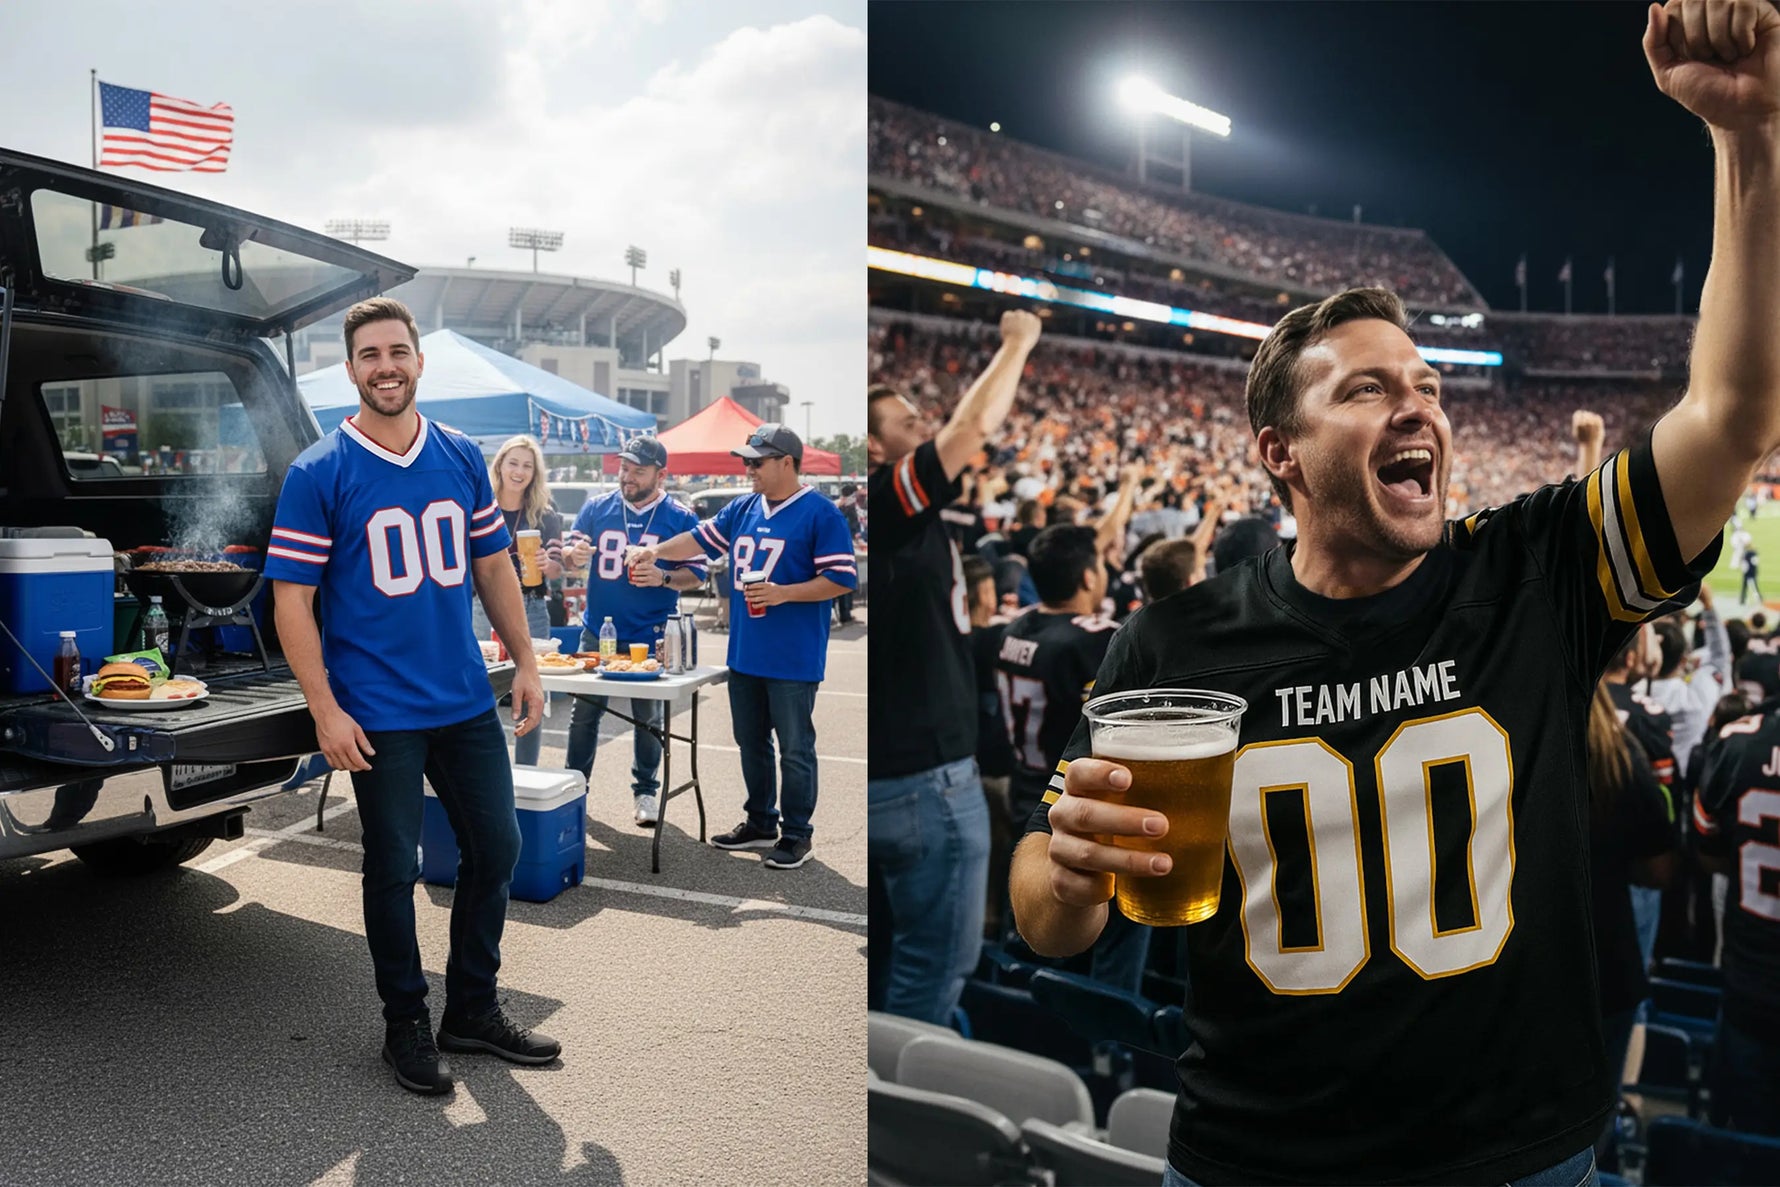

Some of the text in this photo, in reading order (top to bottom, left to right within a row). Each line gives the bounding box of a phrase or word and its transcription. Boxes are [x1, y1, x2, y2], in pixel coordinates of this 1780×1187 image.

[365, 497, 467, 598] 00
[733, 535, 786, 591] 87
[1275, 660, 1461, 727] TEAM NAME
[1761, 745, 1780, 777] J
[1227, 706, 1516, 995] 00
